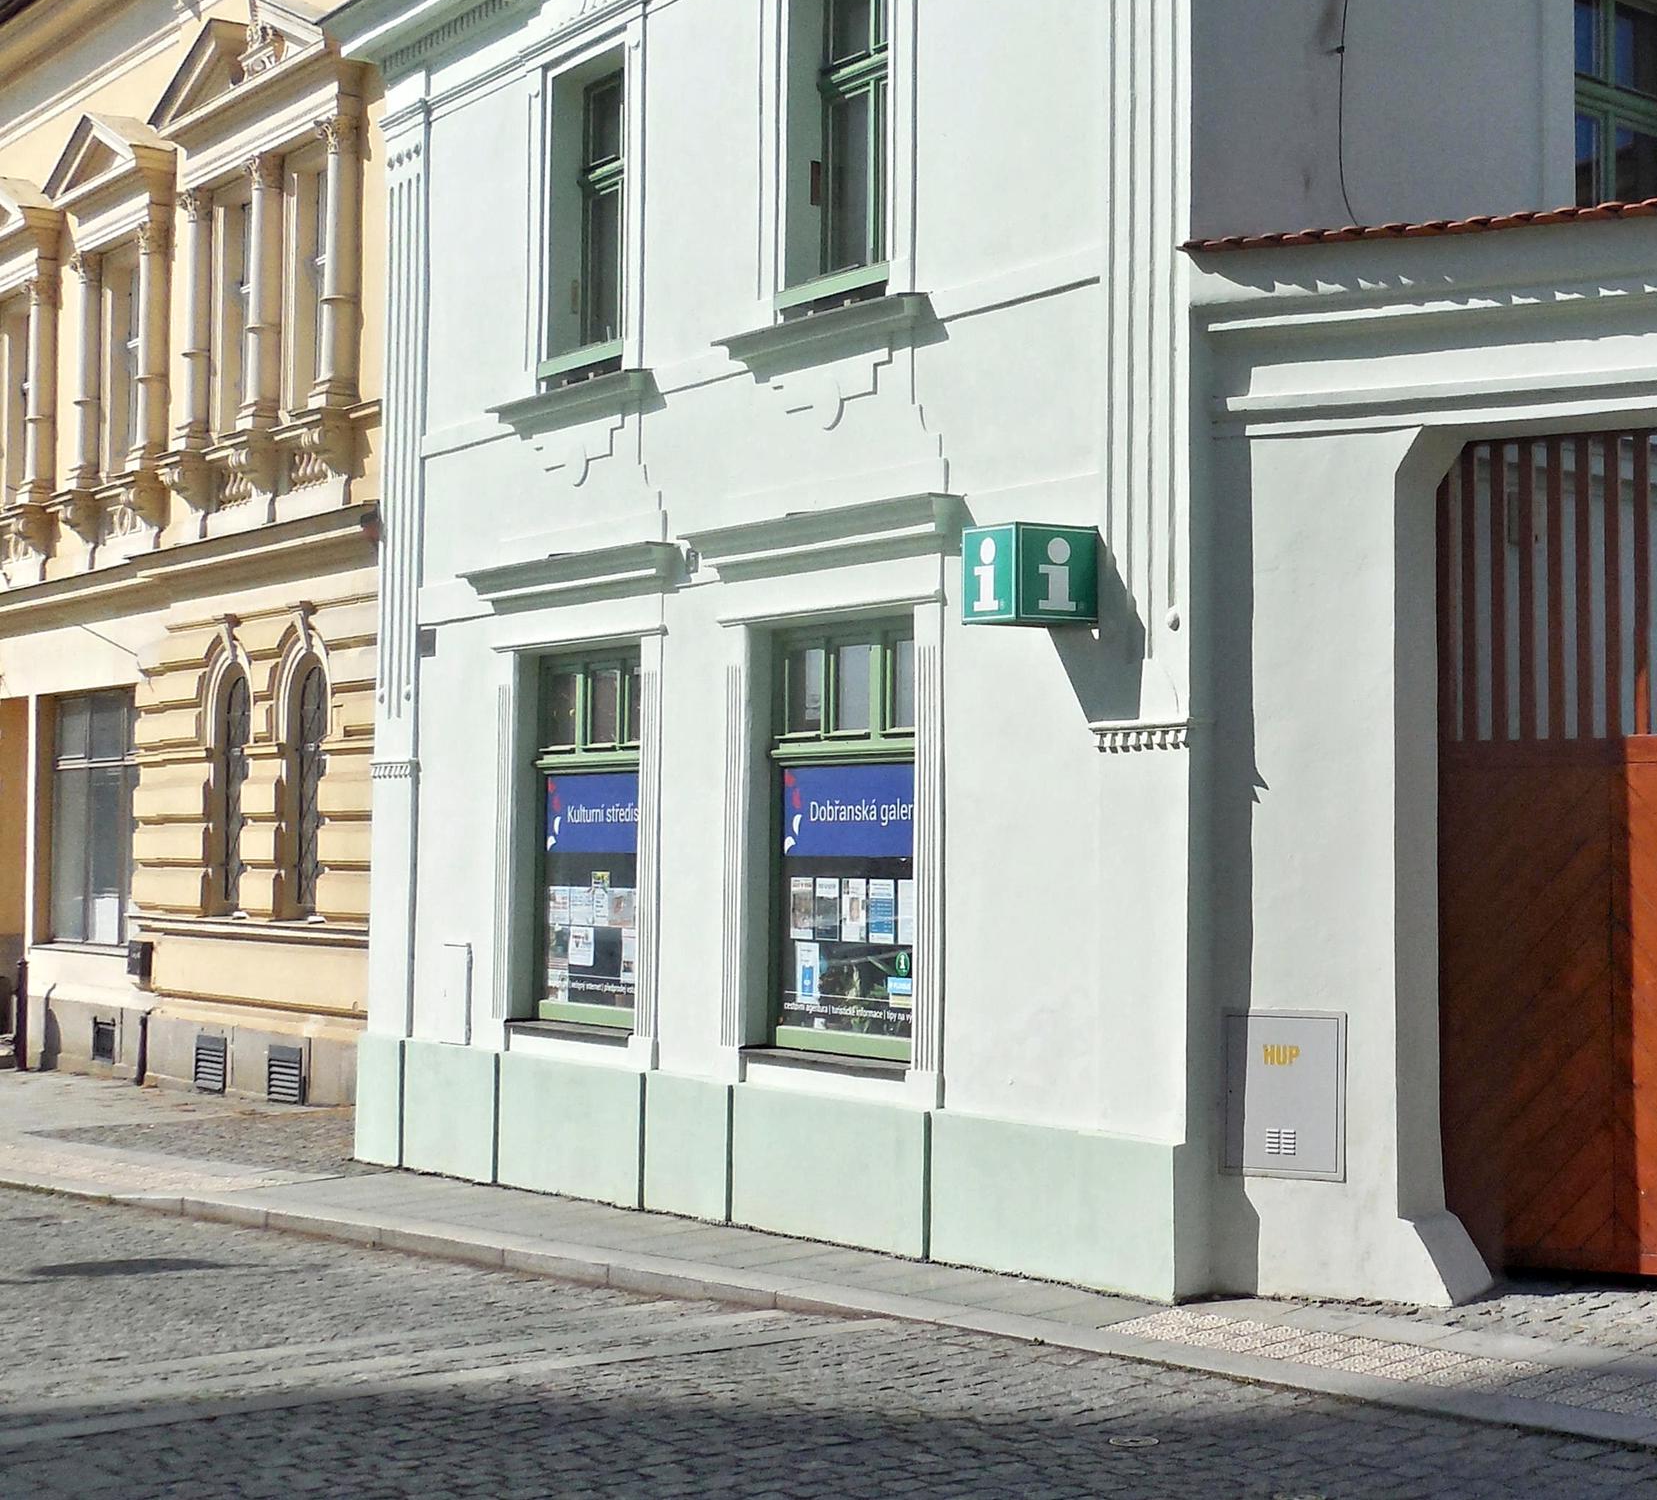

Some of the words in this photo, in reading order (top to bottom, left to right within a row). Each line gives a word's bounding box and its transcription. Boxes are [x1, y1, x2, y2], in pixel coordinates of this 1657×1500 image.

[567, 803, 605, 823] Kulturní
[810, 798, 877, 822] Dobřanská
[1262, 1043, 1301, 1066] HUP
